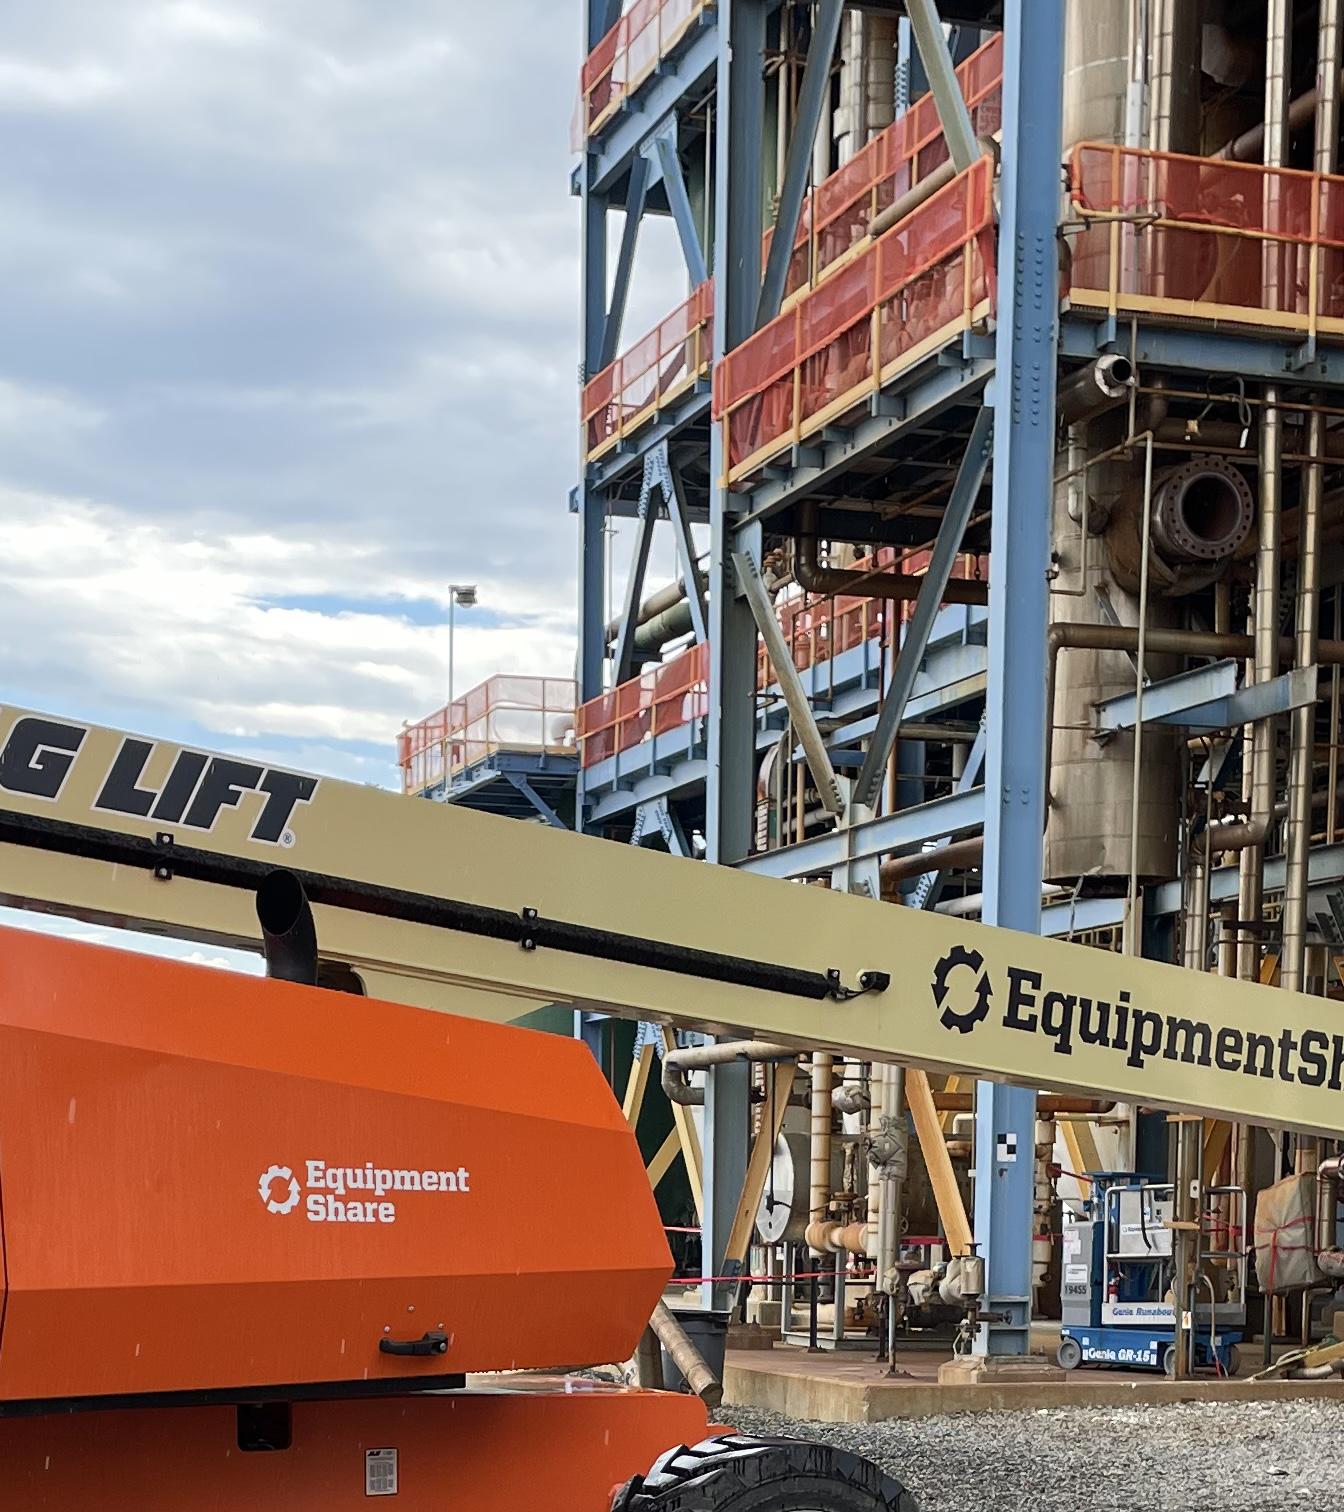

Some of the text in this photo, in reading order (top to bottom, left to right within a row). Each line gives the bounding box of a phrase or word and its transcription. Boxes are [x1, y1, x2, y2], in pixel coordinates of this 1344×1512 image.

[93, 736, 320, 844] LIFT
[305, 1160, 471, 1196] Equipment
[306, 1194, 396, 1223] Share
[1088, 1347, 1151, 1363] Genie GR-15
